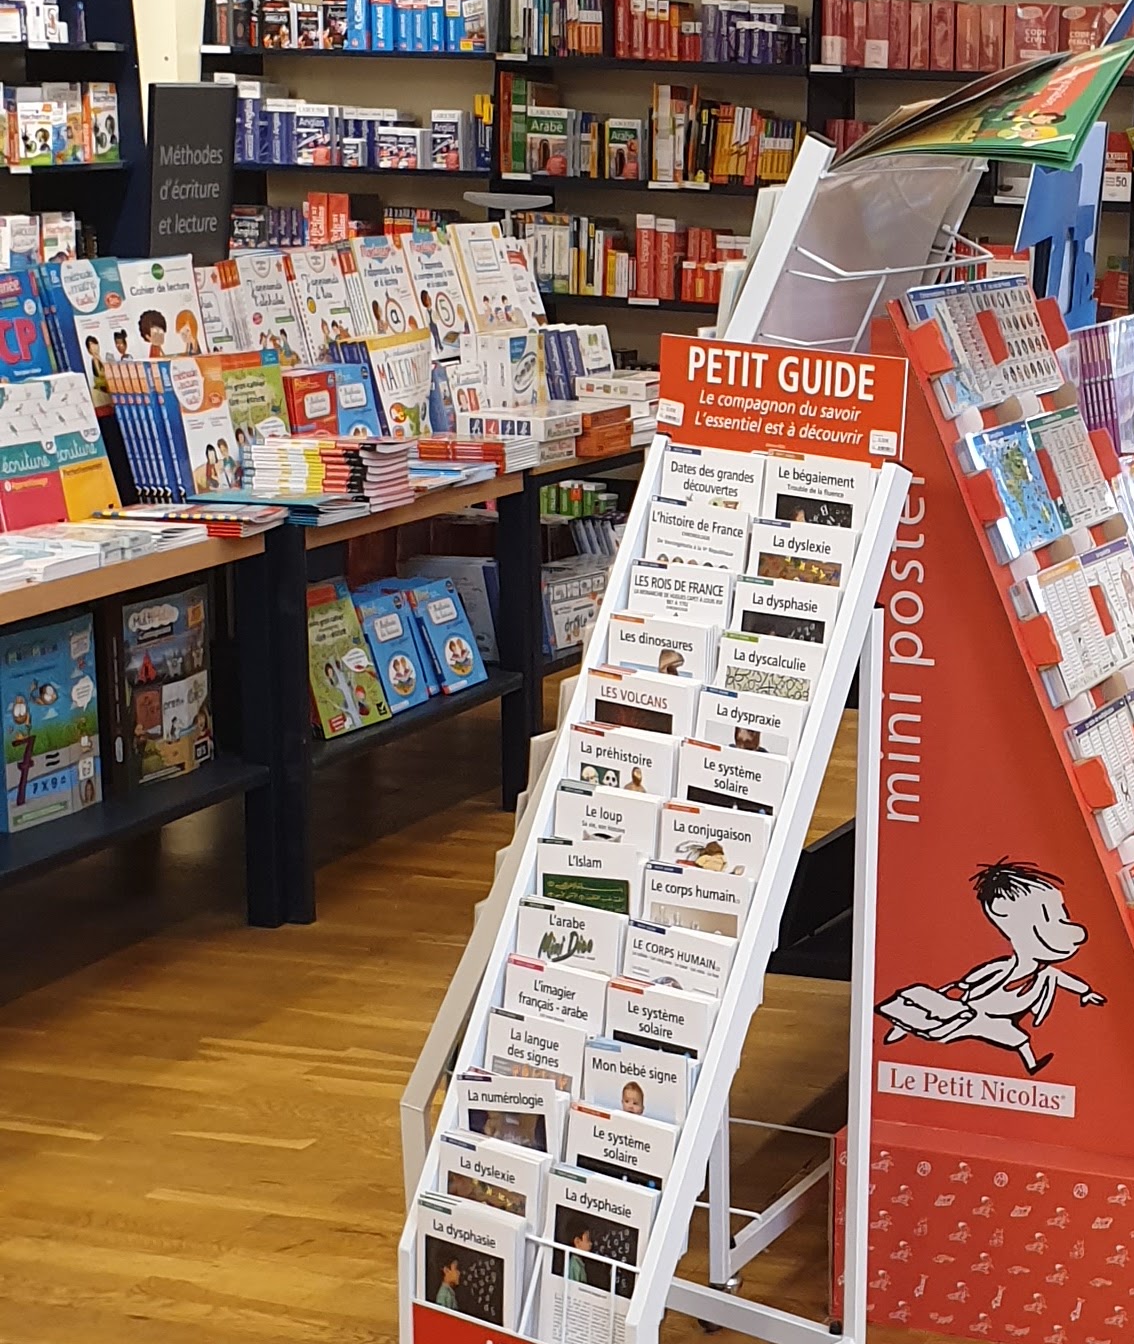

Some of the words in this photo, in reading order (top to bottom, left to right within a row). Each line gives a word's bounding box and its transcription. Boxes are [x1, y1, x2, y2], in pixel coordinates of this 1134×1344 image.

[530, 120, 563, 133] Arabe
[611, 130, 634, 140] Arabe
[160, 145, 223, 166] Méthodes
[160, 179, 220, 200] d'écriture
[1116, 177, 1127, 187] 50
[159, 220, 172, 234] et
[175, 215, 217, 233] lecture
[130, 283, 155, 296] Cahier
[157, 283, 165, 293] de
[167, 282, 190, 292] lecture
[687, 346, 769, 388] PETIT
[778, 356, 875, 401] GUIDE
[700, 389, 715, 405] Le
[718, 393, 795, 415] compagnon
[799, 401, 817, 417] du
[820, 406, 861, 421] savoir
[695, 410, 762, 433] L'essentiel
[765, 421, 784, 436] est
[787, 421, 796, 438] à
[799, 425, 863, 446] découvrir
[671, 461, 696, 475] Dates
[699, 464, 714, 478] des
[717, 466, 754, 483] grandes
[778, 466, 789, 478] Le
[792, 468, 855, 489] bégaiement
[684, 479, 738, 497] découvertes
[653, 510, 695, 529] L'histoire
[698, 519, 709, 531] de
[712, 522, 743, 538] France
[773, 535, 784, 547] La
[788, 537, 831, 554] dyslexie
[635, 574, 648, 587] LES
[651, 577, 672, 591] ROIS
[674, 581, 686, 592] DE
[689, 582, 724, 597] FRANCE
[753, 593, 764, 605] La
[767, 595, 818, 614] dysphasie
[620, 629, 636, 642] Les
[638, 631, 693, 651] dinosaures
[734, 648, 745, 660] La
[749, 650, 806, 671] dyscalculie
[601, 685, 618, 699] LES
[620, 687, 668, 710] VOLCANS
[717, 704, 728, 716] La
[731, 706, 781, 728] dyspraxie
[580, 741, 592, 754] La
[596, 743, 653, 768] préhistoire
[881, 692, 922, 822] mini
[704, 757, 715, 771] Le
[718, 762, 761, 783] système
[714, 778, 749, 795] solaire
[586, 805, 597, 818] Le
[600, 806, 623, 823] loup
[673, 819, 685, 832] La
[688, 821, 751, 843] conjugaison
[651, 879, 663, 892] Le
[665, 881, 693, 898] corps
[696, 882, 735, 903] humain
[550, 914, 586, 931] L'arabe
[633, 939, 643, 950] LE
[646, 942, 675, 959] CORPS
[677, 950, 716, 971] HUMAIN
[534, 980, 576, 1000] L'imagier
[519, 992, 554, 1012] français
[561, 1004, 588, 1021] arabe
[627, 1001, 639, 1015] Le
[642, 1006, 685, 1026] système
[510, 1028, 522, 1041] La
[525, 1029, 560, 1051] langue
[639, 1022, 673, 1039] solaire
[507, 1045, 525, 1059] des
[527, 1050, 559, 1068] signes
[592, 1057, 616, 1072] Mon
[619, 1060, 647, 1079] bébé
[649, 1065, 677, 1084] signe
[468, 1090, 479, 1101] La
[481, 1091, 544, 1107] numérologie
[890, 1068, 915, 1090] Le
[923, 1072, 973, 1098] Petit
[981, 1080, 1060, 1110] Nicolas
[593, 1126, 605, 1138] Le
[608, 1129, 650, 1152] système
[603, 1149, 638, 1166] solaire
[460, 1157, 471, 1170] La
[474, 1160, 516, 1184] dyslexie
[566, 1188, 577, 1202] La
[580, 1192, 632, 1218] dysphasie
[433, 1219, 444, 1232] La
[447, 1222, 496, 1248] dysphasie
